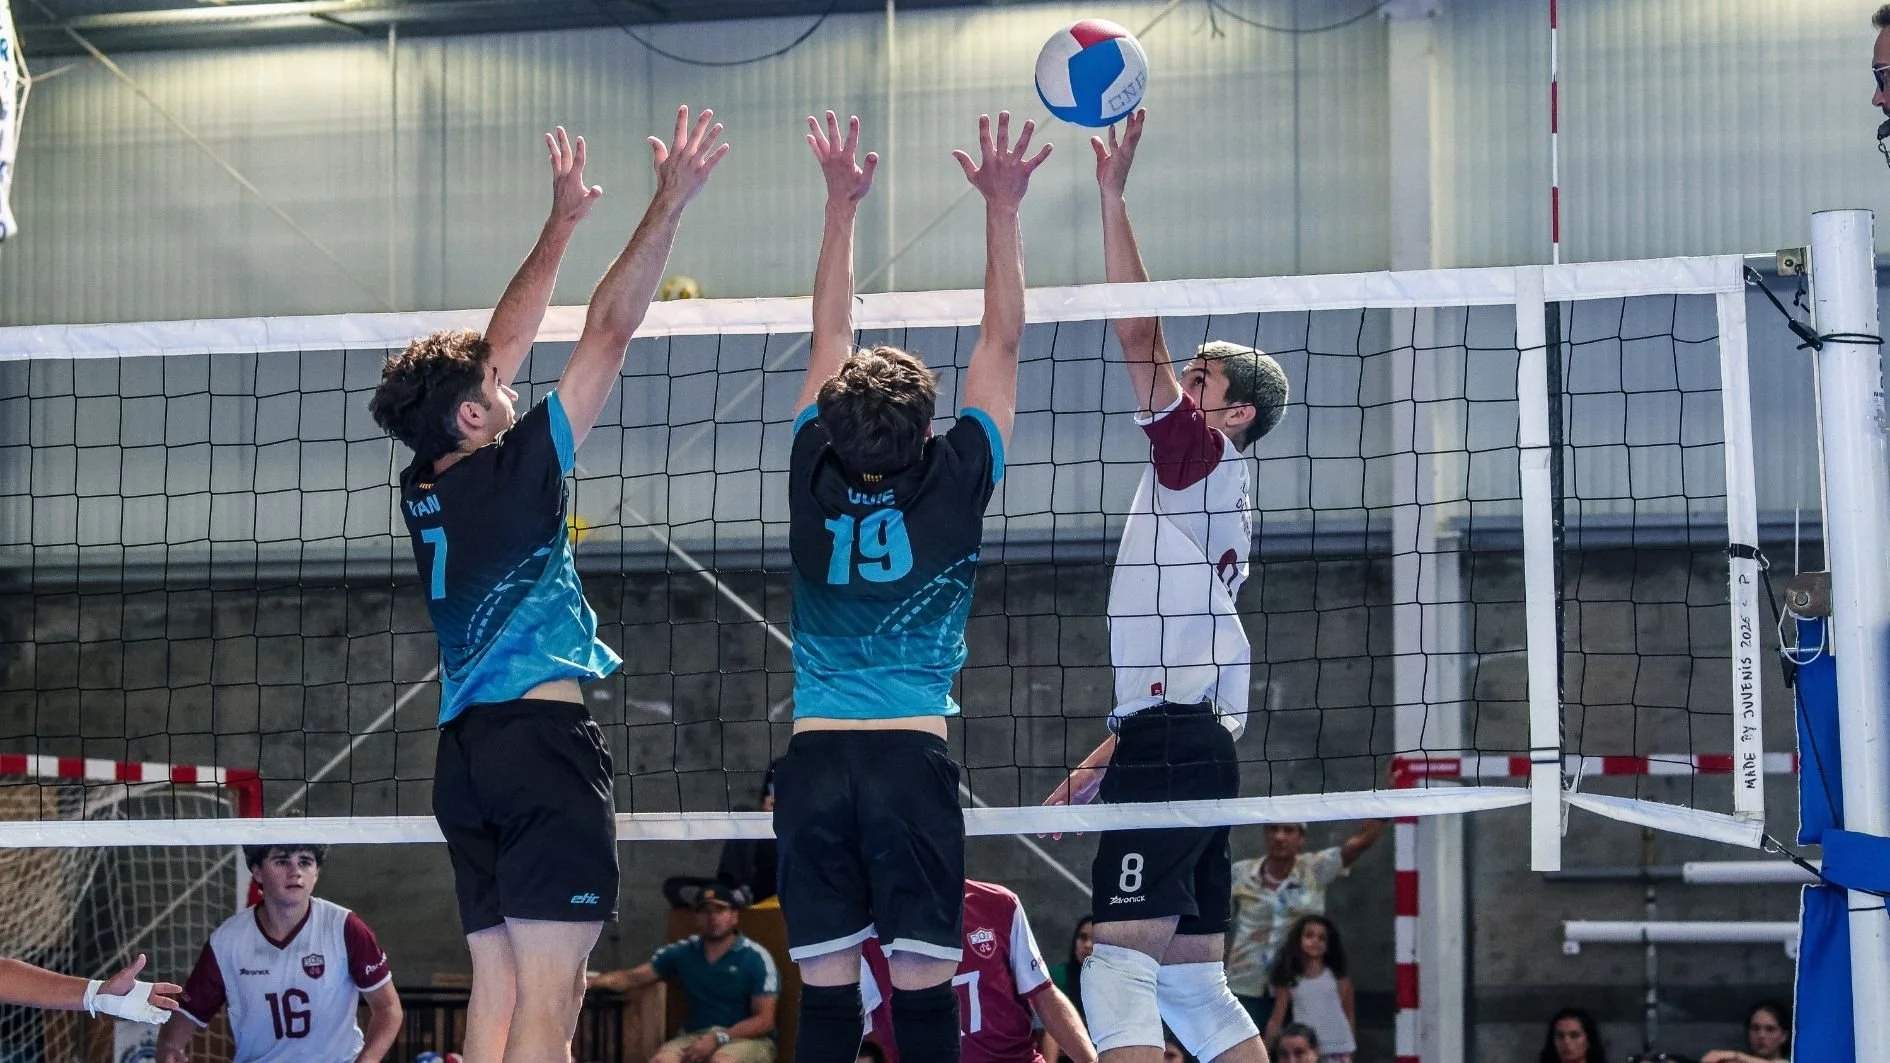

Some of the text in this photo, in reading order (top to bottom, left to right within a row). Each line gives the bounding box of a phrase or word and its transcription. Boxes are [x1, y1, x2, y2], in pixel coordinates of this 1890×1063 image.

[421, 526, 447, 600] 7
[825, 508, 914, 585] 19
[1743, 751, 1757, 790] MADE
[1119, 852, 1144, 893] 8
[265, 988, 311, 1040] 16
